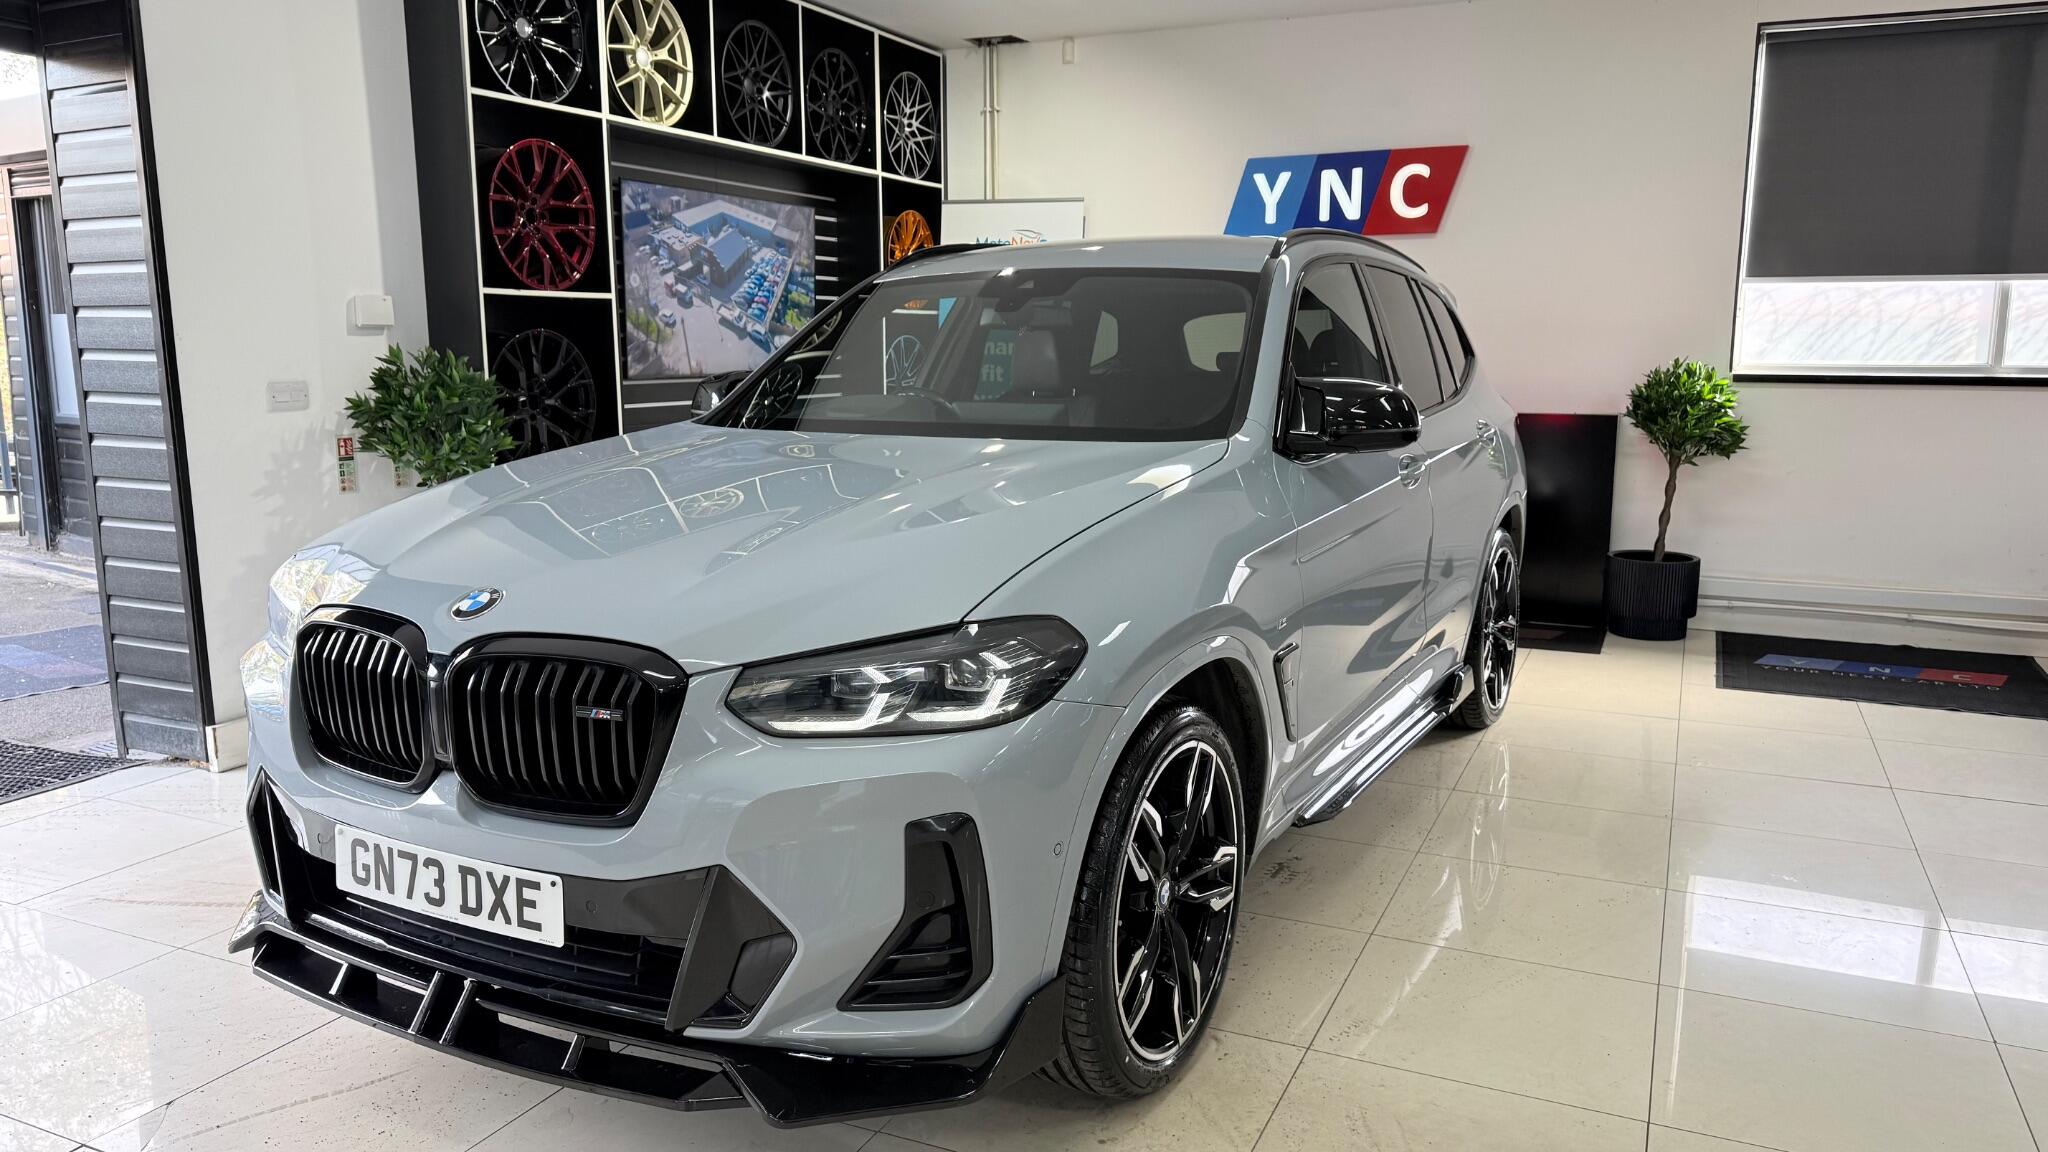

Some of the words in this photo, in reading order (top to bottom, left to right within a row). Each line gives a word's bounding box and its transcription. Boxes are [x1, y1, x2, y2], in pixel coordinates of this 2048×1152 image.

[1253, 163, 1430, 224] YNC
[982, 364, 1005, 382] fit
[351, 838, 446, 907] GN73
[458, 864, 543, 933] DXE
